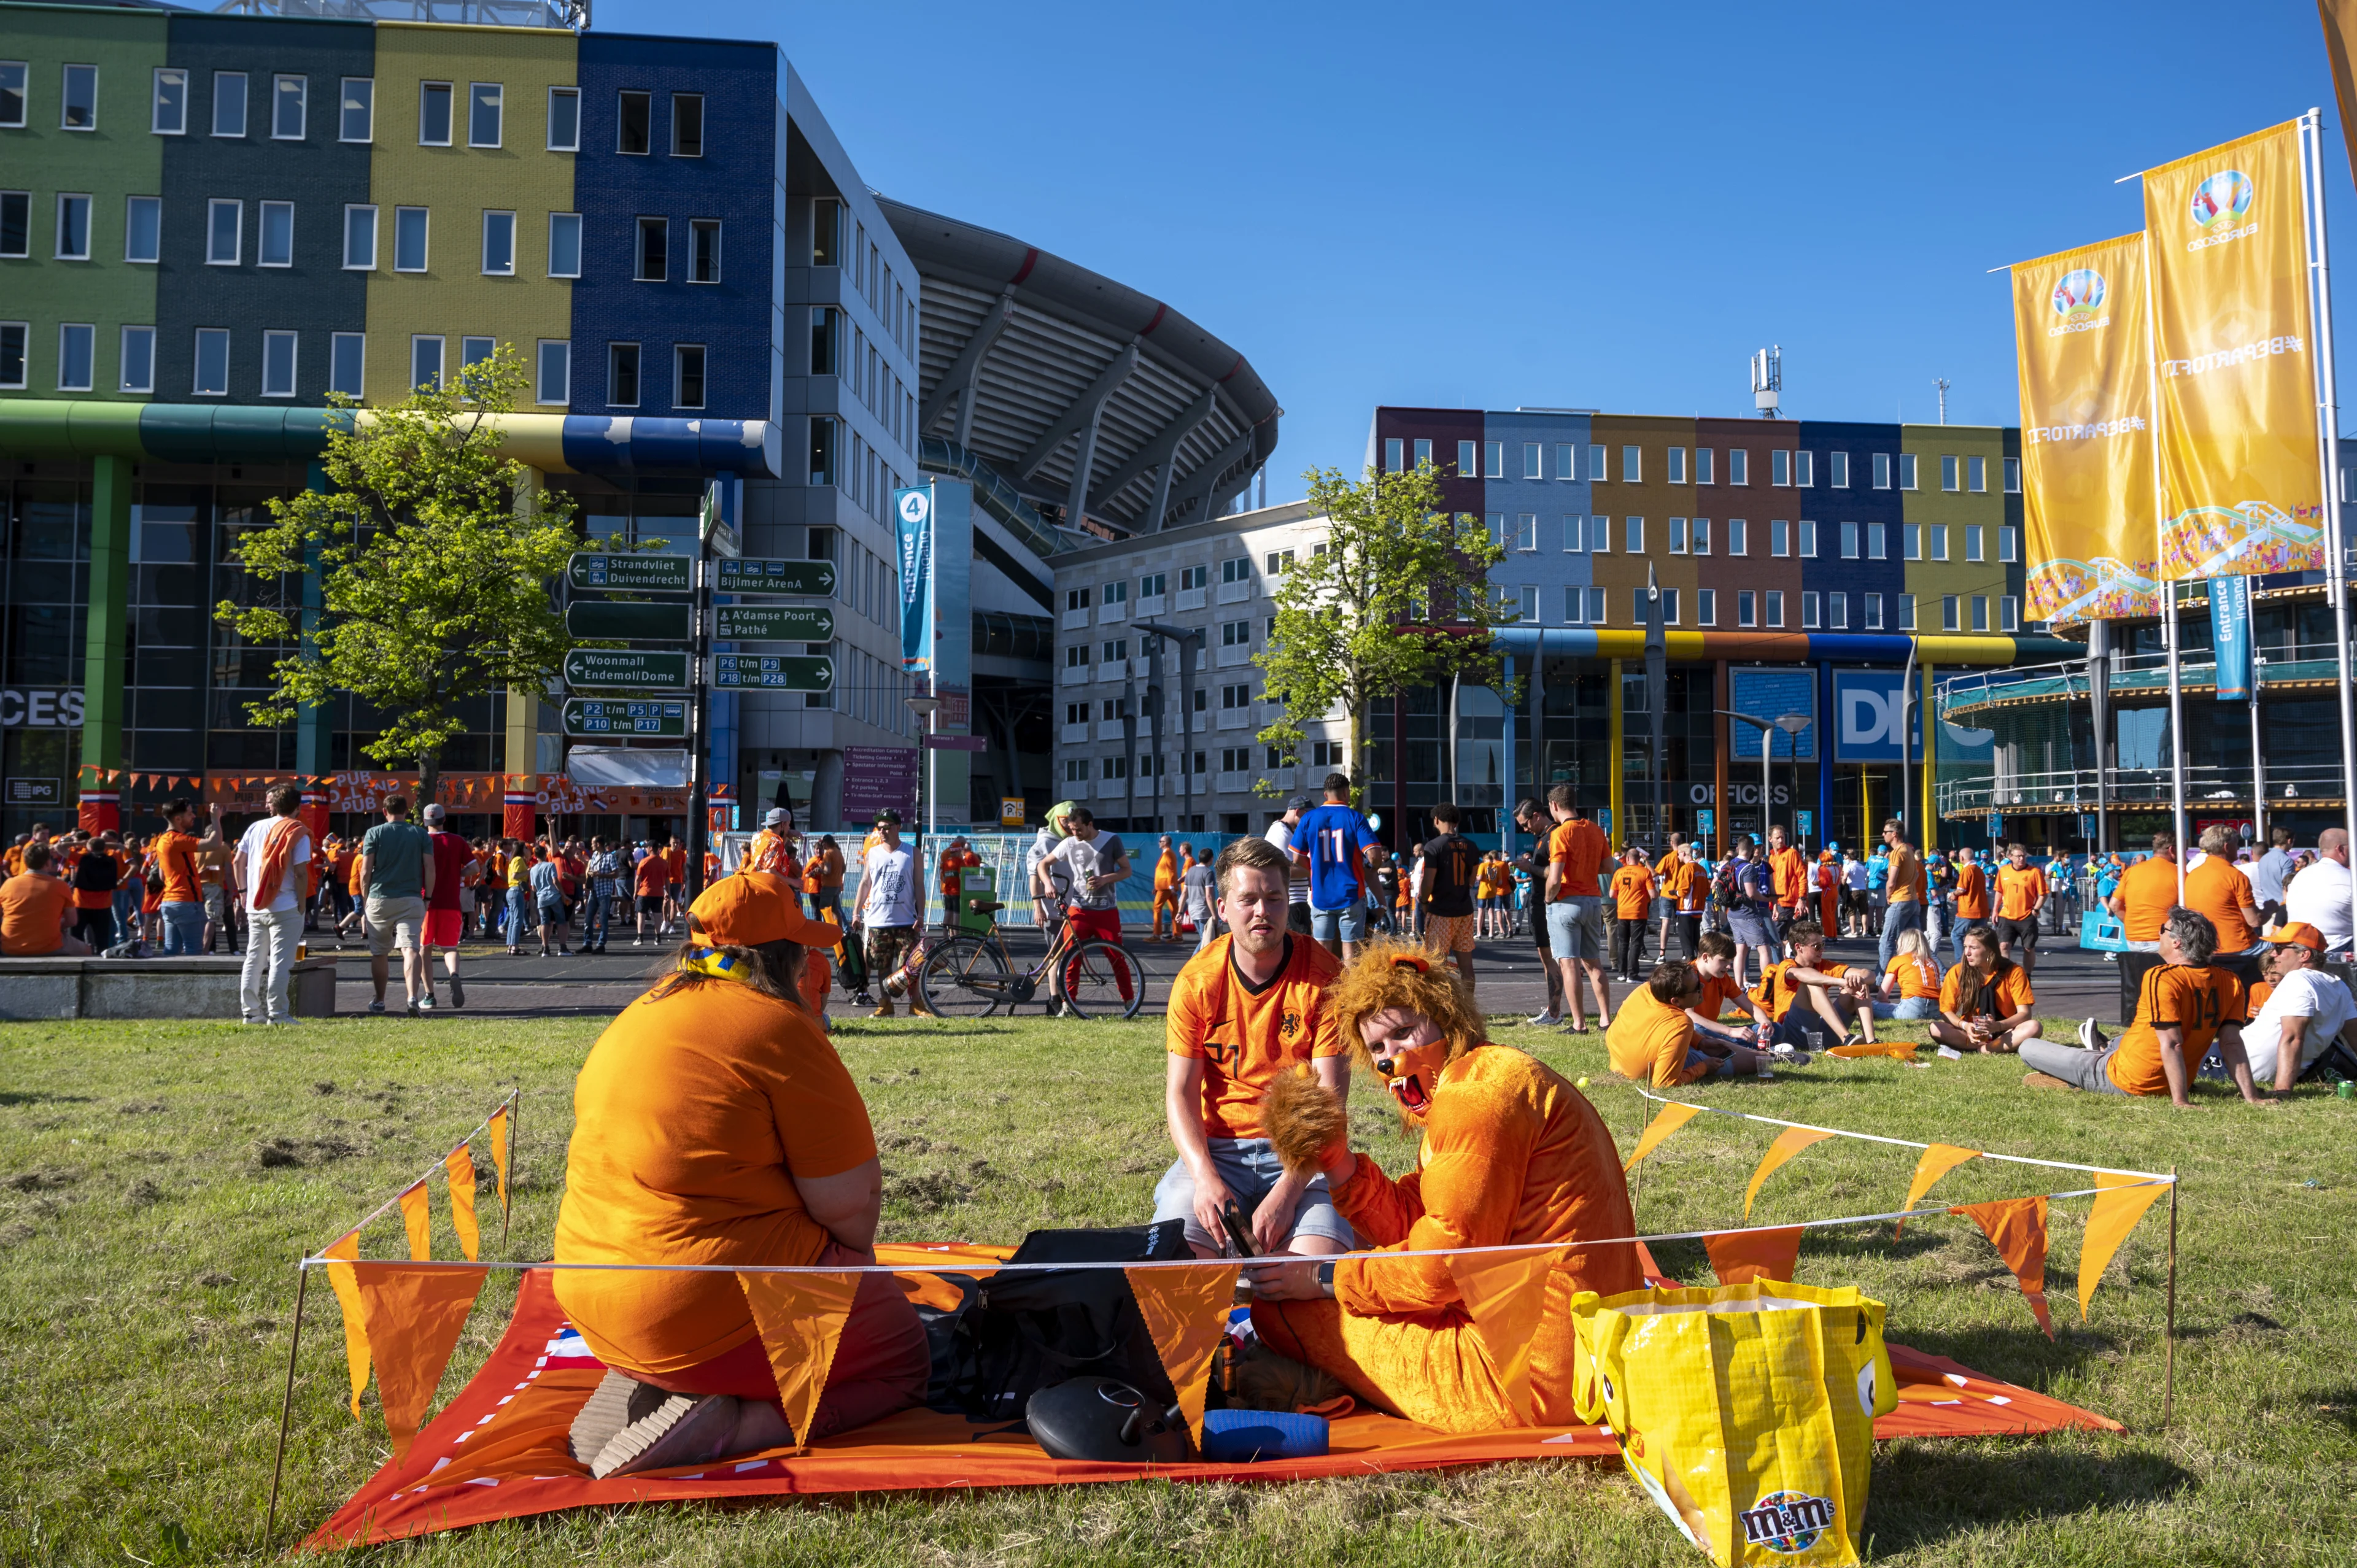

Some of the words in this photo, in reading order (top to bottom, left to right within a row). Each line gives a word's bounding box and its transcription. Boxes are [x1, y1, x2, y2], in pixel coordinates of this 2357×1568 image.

[906, 497, 920, 516] 4
[919, 531, 931, 579] Ingang
[611, 559, 675, 570] Strandvliet
[904, 533, 916, 603] Entrance
[611, 573, 686, 584] Duivendrecht
[721, 577, 764, 589] Bijlmer
[767, 579, 802, 589] ArenA
[2233, 576, 2247, 620] Ingang
[732, 611, 780, 620] A'damse
[784, 611, 816, 620] Poort
[2216, 580, 2232, 642] Entrance
[735, 625, 767, 635] Pathé
[586, 655, 644, 666] Woonmall
[721, 659, 734, 668] P6
[740, 658, 757, 668] t/m
[764, 660, 777, 669] P9
[584, 670, 675, 681] Endemol/Dome
[721, 673, 738, 682] P18
[743, 674, 759, 683] t/m
[764, 674, 784, 684] P28
[0, 690, 84, 726] CES
[586, 705, 600, 714] P2
[606, 705, 625, 714] t/m
[630, 706, 644, 714] P5
[586, 720, 607, 728] P10
[613, 720, 632, 729] t/m
[637, 720, 657, 729] P17
[336, 771, 371, 787] PUB
[32, 786, 52, 795] IPG
[341, 797, 376, 813] PUB
[551, 798, 585, 814] PUB
[1318, 828, 1344, 863] 11
[1623, 877, 1631, 890] 9
[2014, 884, 2019, 894] 7
[2193, 987, 2220, 1030] 14
